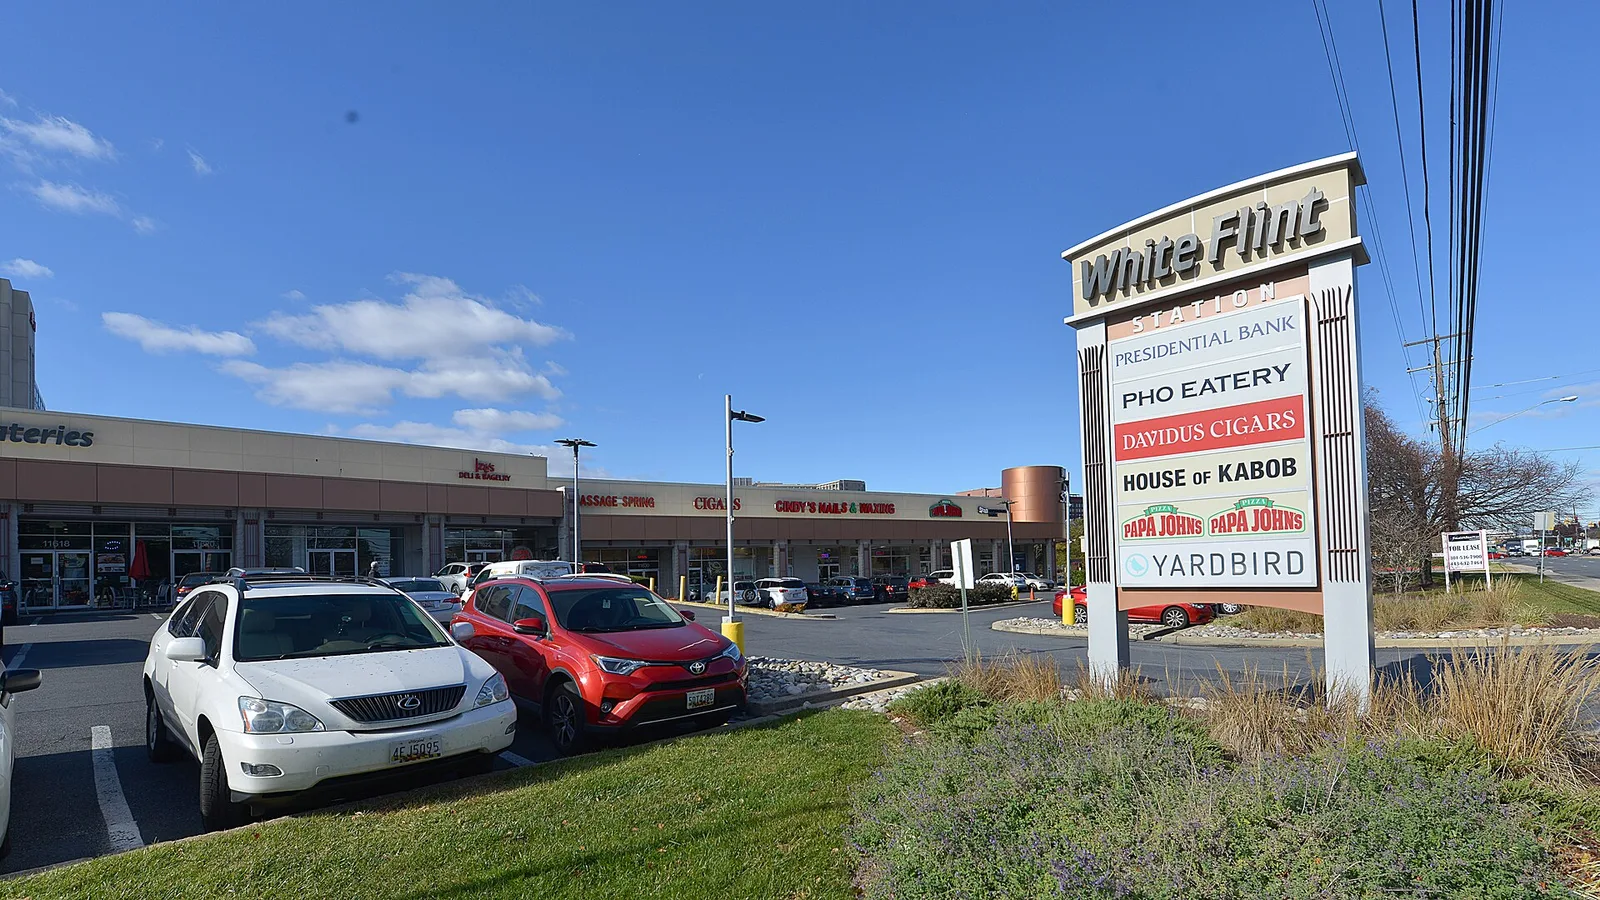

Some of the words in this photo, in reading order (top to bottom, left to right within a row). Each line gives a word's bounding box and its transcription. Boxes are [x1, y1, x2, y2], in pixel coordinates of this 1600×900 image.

[1081, 233, 1200, 301] White
[1208, 186, 1324, 264] Flint
[1132, 281, 1276, 334] STATION
[1115, 330, 1233, 367] PRESIDENTIAL
[1239, 315, 1296, 341] BANK
[1122, 386, 1174, 409] PHO
[1181, 363, 1292, 399] EATERY
[1122, 423, 1205, 450] DAVIDUS
[1210, 409, 1296, 437] CIGARS
[1123, 469, 1186, 492] HOUSE
[1192, 471, 1211, 485] OF
[1218, 457, 1297, 483] KABOB
[580, 494, 618, 507] ASSAGE
[622, 496, 655, 508] SPRING
[775, 500, 817, 514] CINDY'S
[818, 502, 848, 514] NAILS
[849, 502, 857, 514] &
[859, 502, 896, 514] WAXING
[1150, 505, 1173, 513] PIZZA
[1242, 497, 1268, 506] PIZZA
[1124, 515, 1157, 537] PAPA
[1210, 509, 1249, 534] PAPA
[42, 540, 71, 548] 11618
[1152, 550, 1305, 577] YARDBIRD
